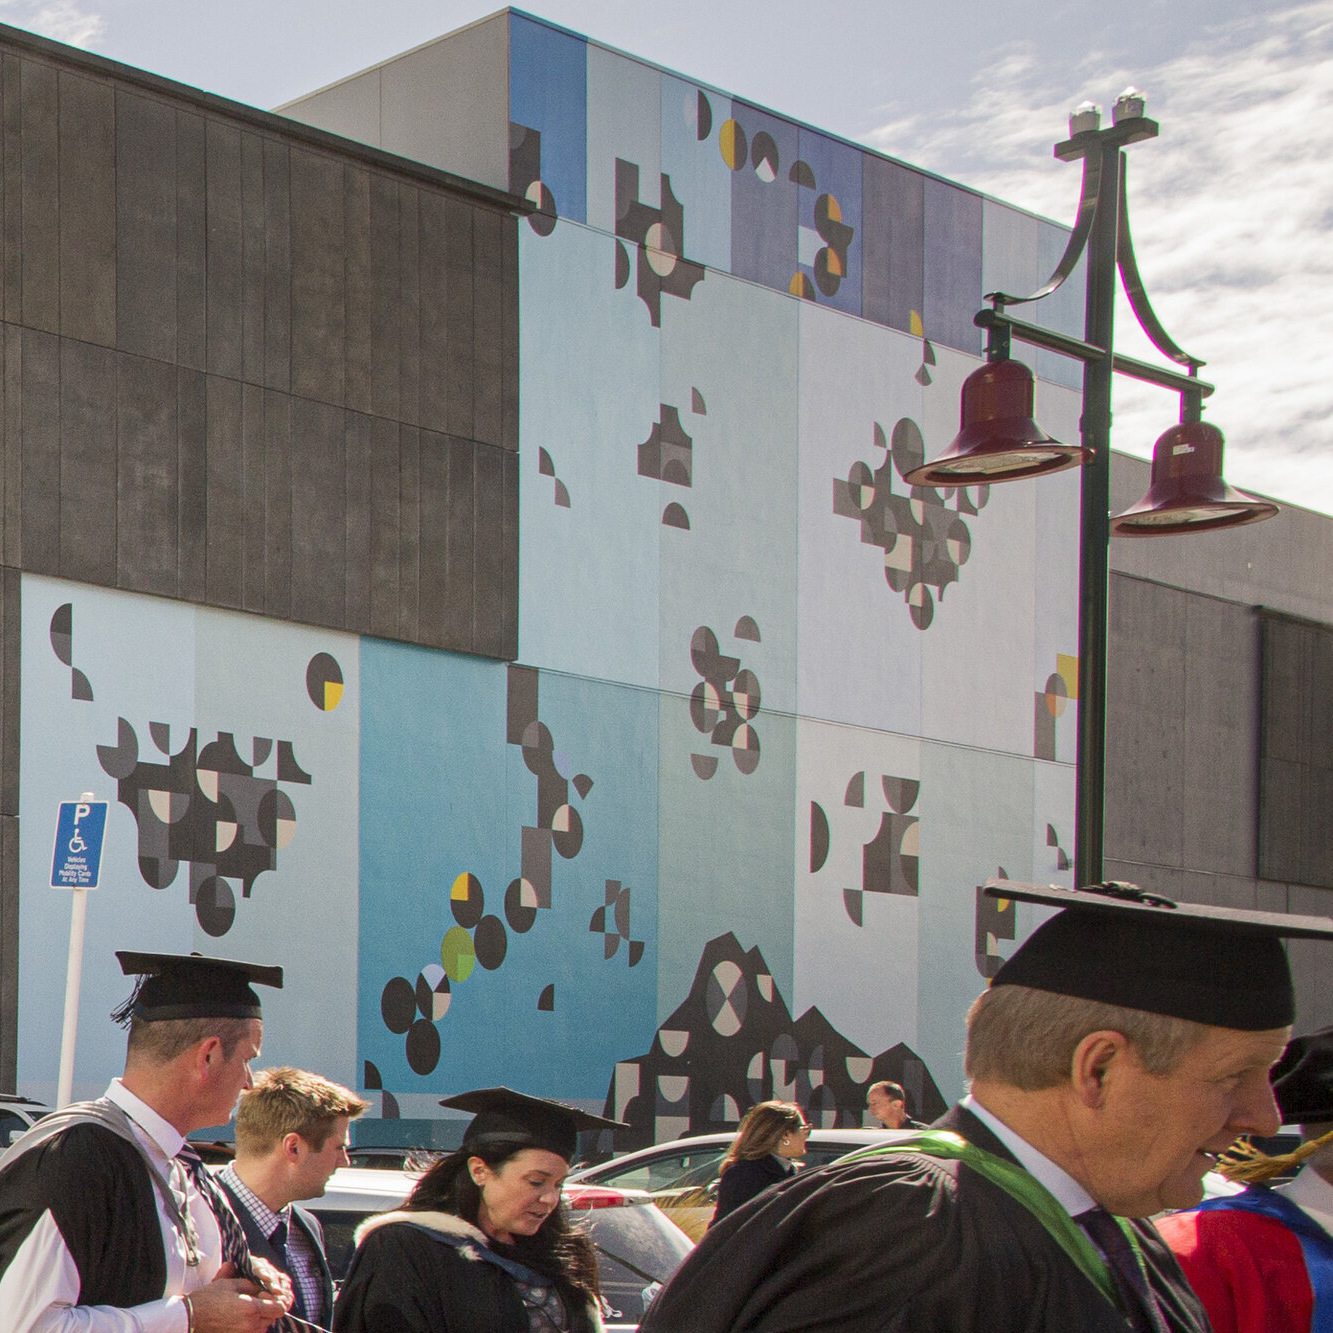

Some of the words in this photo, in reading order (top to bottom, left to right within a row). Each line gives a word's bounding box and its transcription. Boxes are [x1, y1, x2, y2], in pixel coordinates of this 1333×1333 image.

[74, 804, 91, 825] P
[64, 863, 88, 871] Displaying
[58, 870, 77, 878] Mobility
